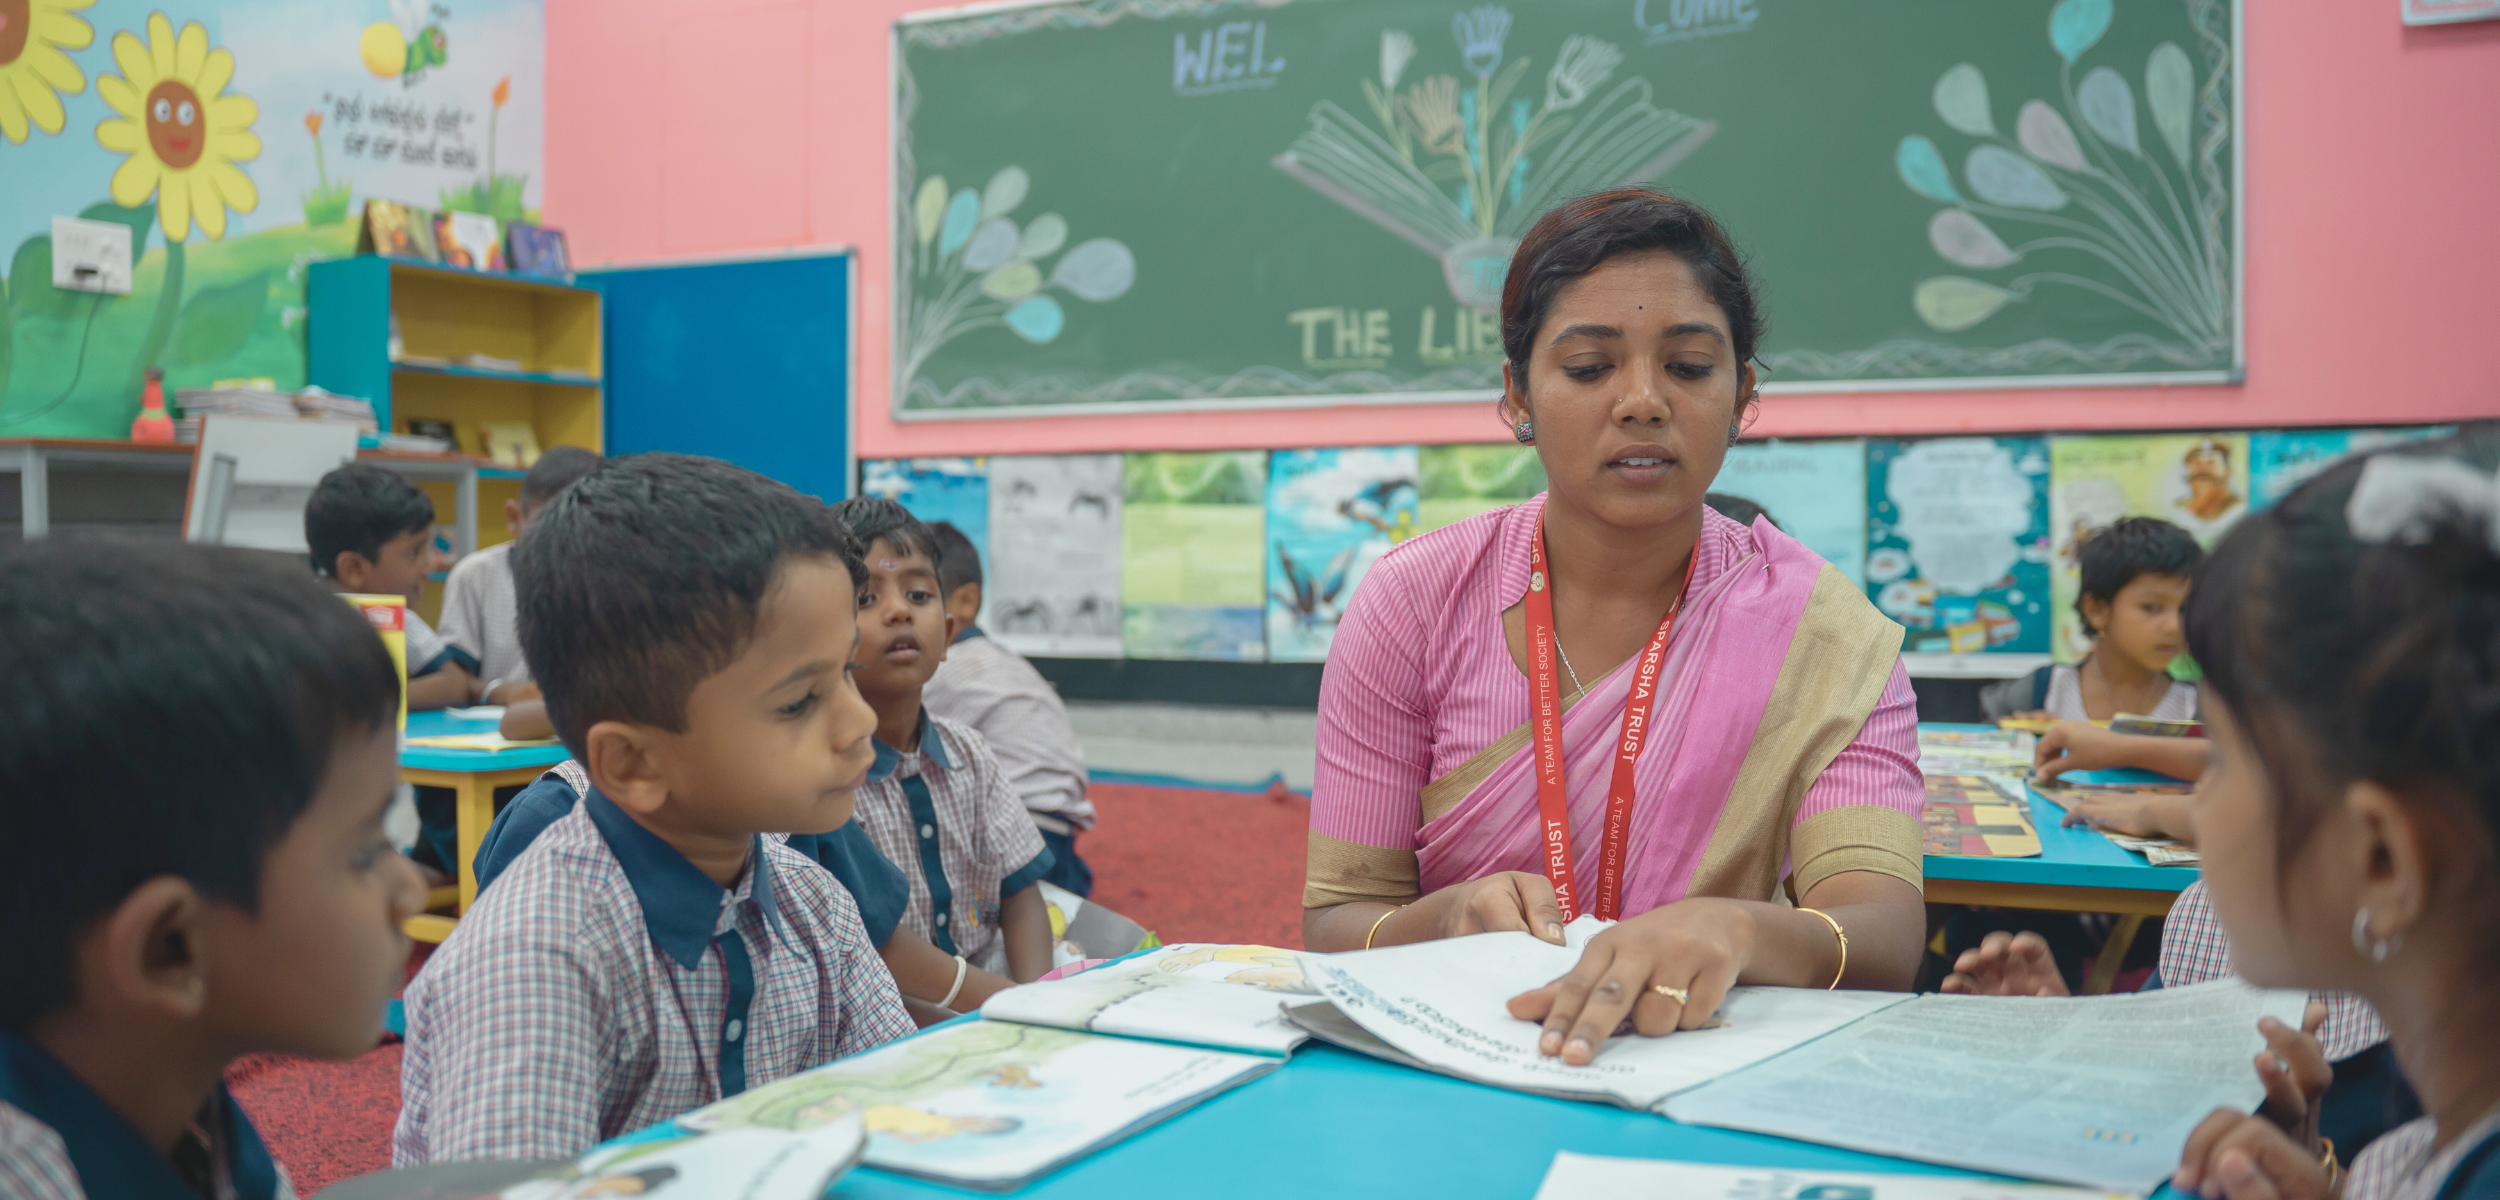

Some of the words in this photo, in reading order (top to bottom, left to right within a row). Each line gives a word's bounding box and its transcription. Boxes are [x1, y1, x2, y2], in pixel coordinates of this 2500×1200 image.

[1173, 19, 1287, 86] WEL
[1287, 305, 1393, 358] THE
[1536, 624, 1549, 670] SOCIETY
[1634, 620, 1670, 700] SPARSHA
[1539, 672, 1552, 716] BETTER
[1543, 718, 1554, 743] FOR
[1622, 705, 1646, 764] TRUST
[1544, 744, 1556, 776] TEAM
[1547, 776, 1557, 785] A
[1614, 796, 1625, 805] A
[1609, 808, 1623, 840] TEAM
[1547, 819, 1566, 879] TRUST
[1606, 841, 1618, 866] FOR
[1601, 868, 1615, 913] BETTER
